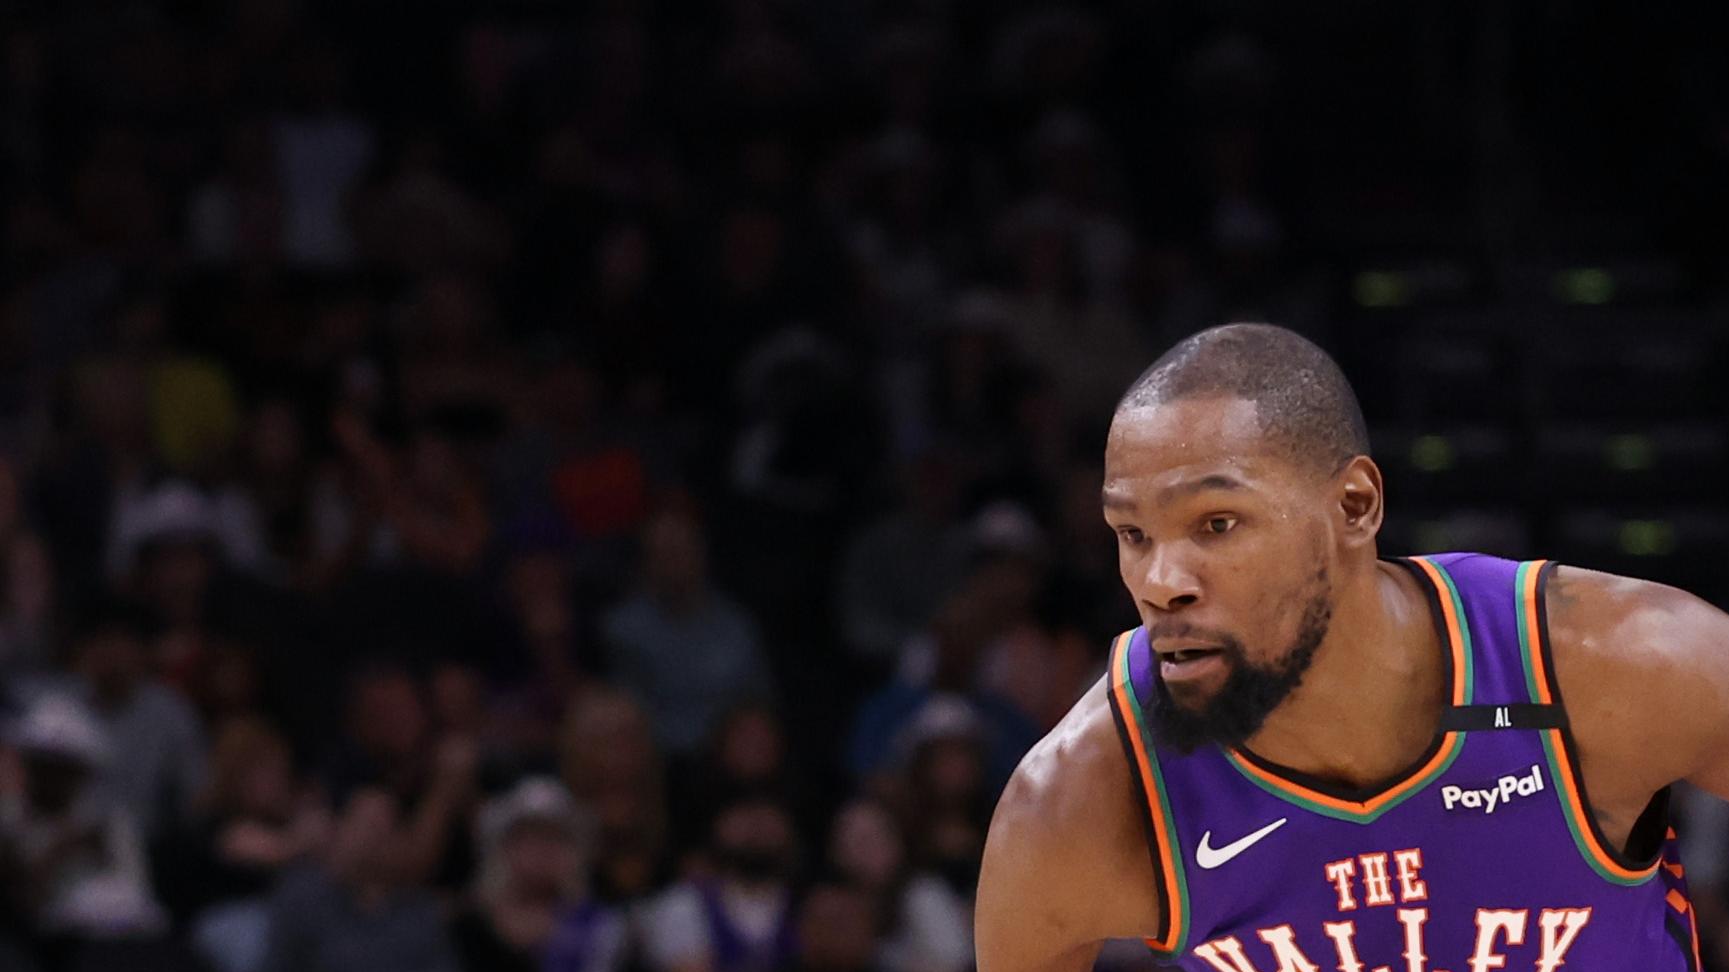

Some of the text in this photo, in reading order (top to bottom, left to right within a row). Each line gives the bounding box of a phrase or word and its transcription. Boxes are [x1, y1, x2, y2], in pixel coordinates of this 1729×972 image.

[1494, 706, 1513, 728] AL
[1441, 764, 1544, 814] PayPal
[1326, 847, 1428, 912] THE
